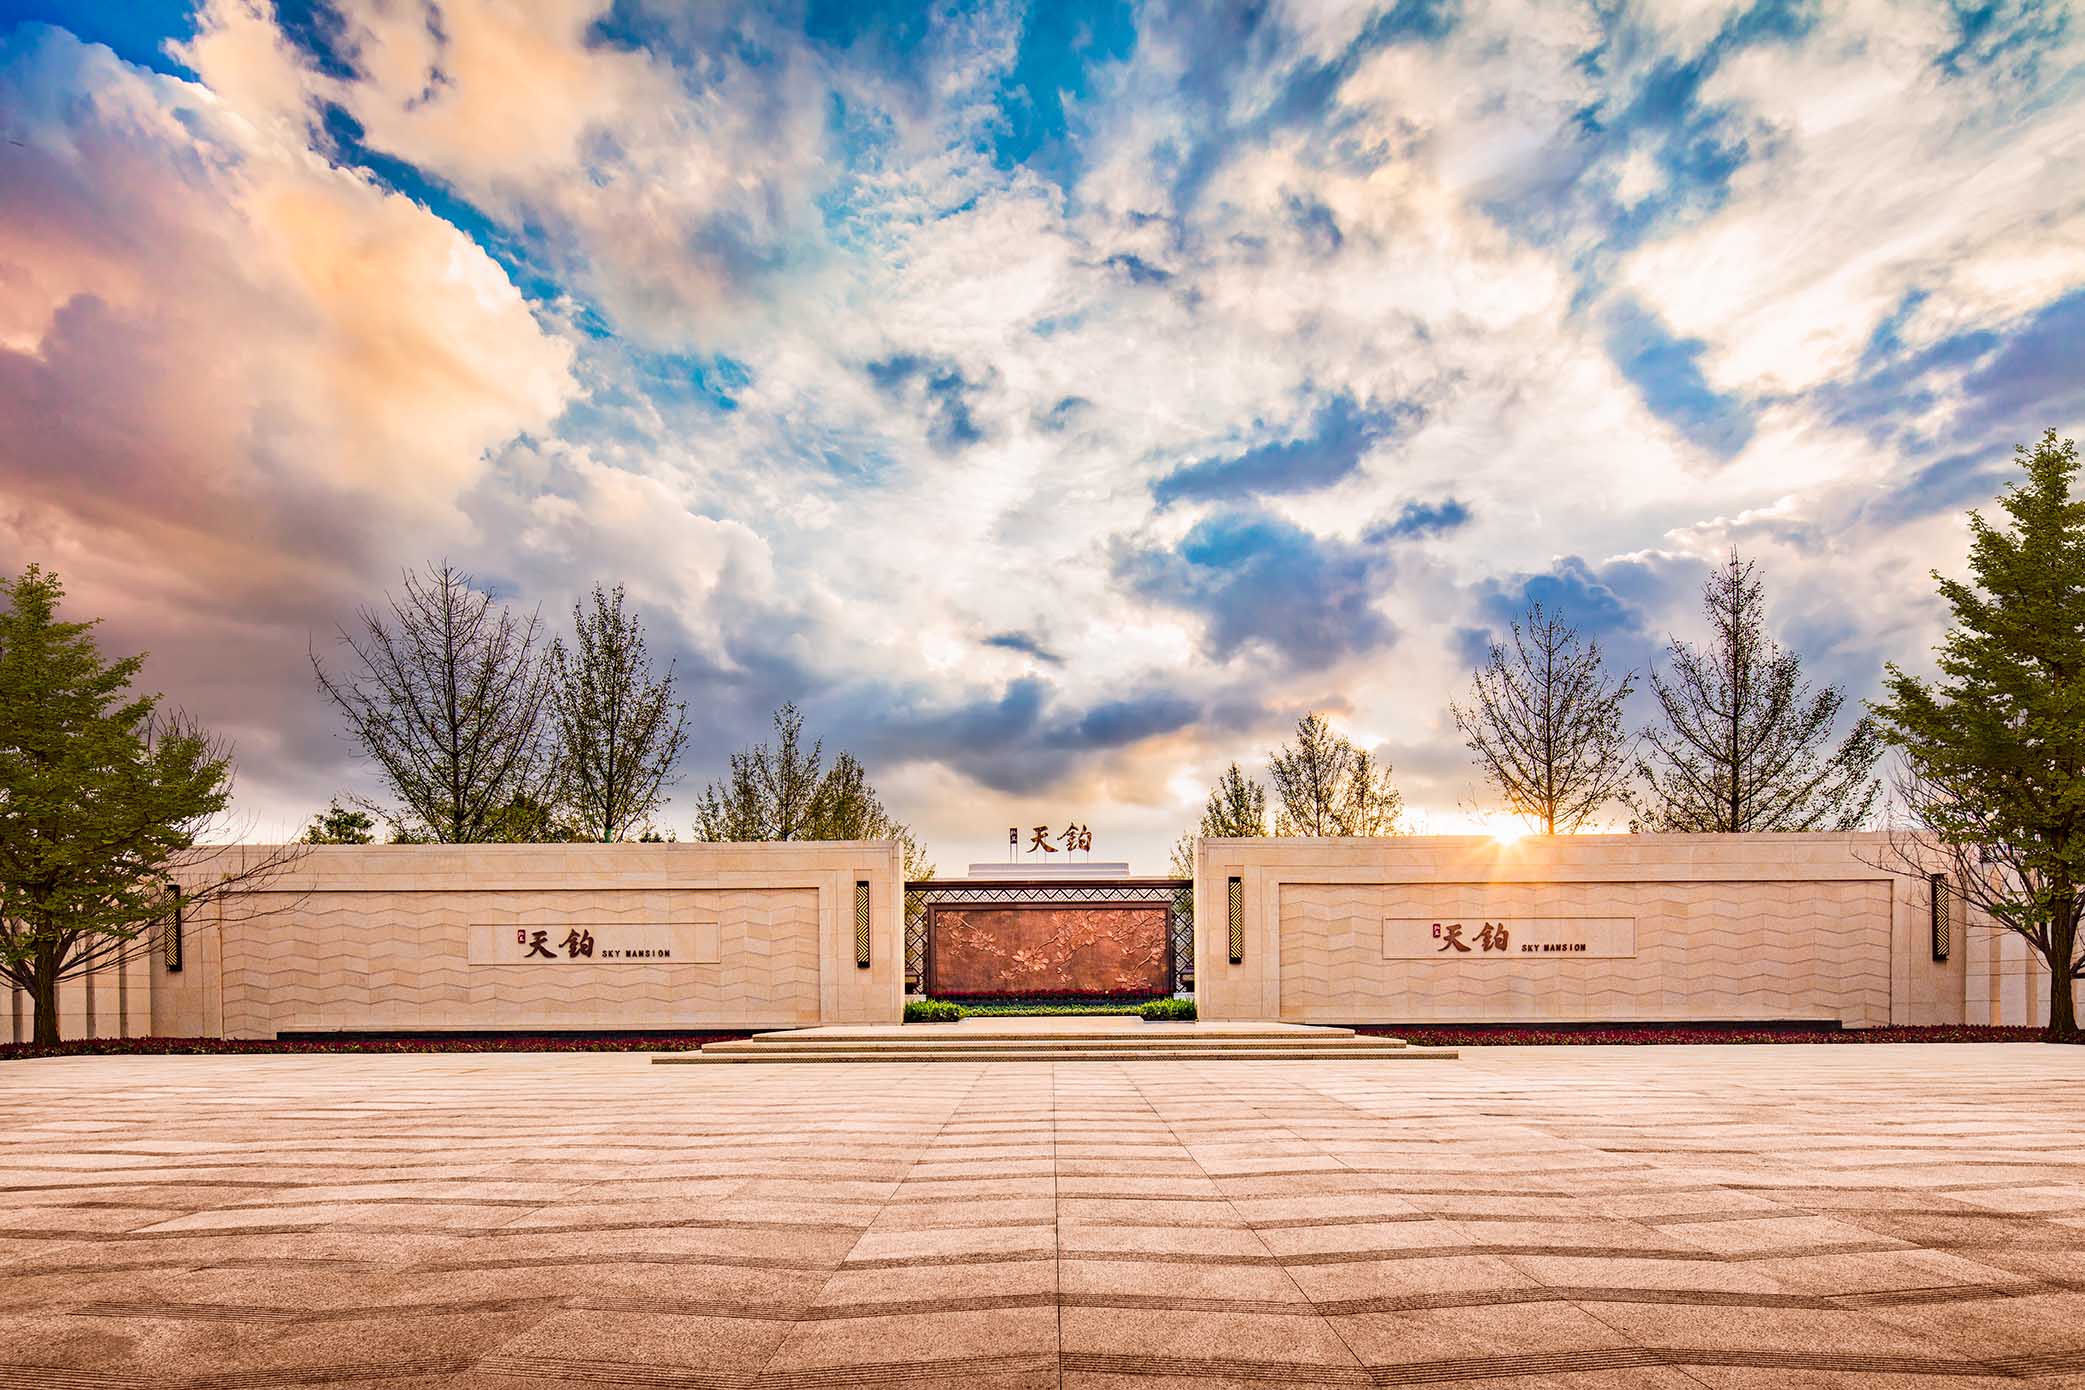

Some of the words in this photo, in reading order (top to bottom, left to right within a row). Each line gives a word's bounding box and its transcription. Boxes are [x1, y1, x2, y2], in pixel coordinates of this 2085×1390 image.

[1521, 944, 1539, 952] SKY
[1543, 943, 1586, 952] MANSION
[602, 950, 620, 958] SKY
[626, 949, 670, 958] MANSION
